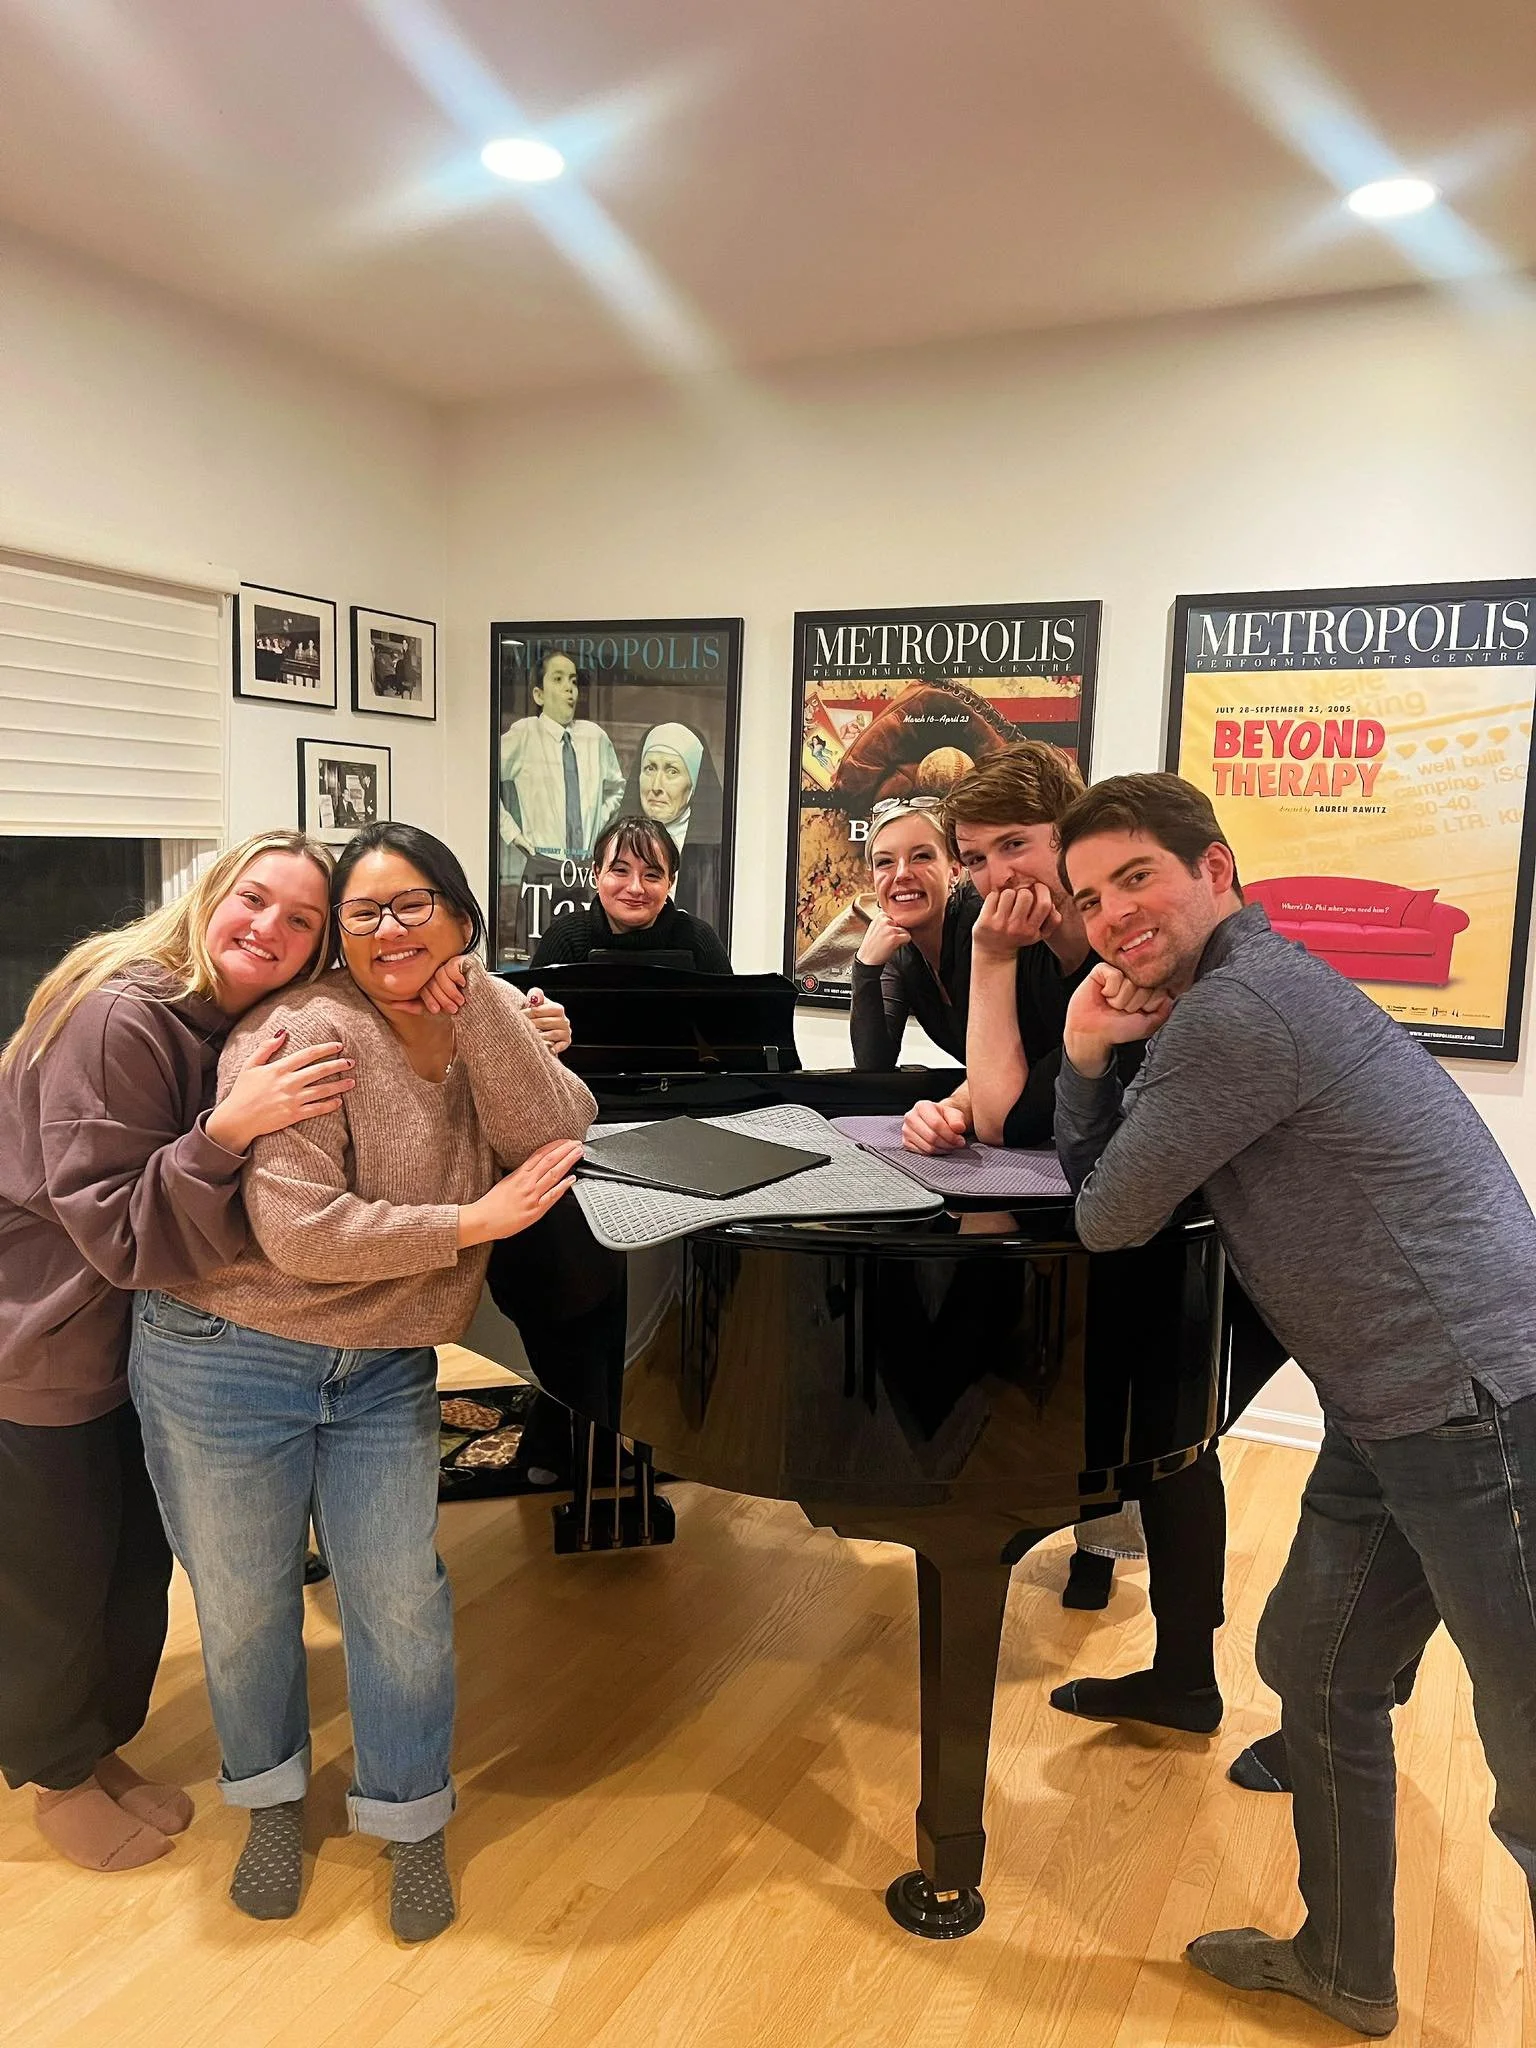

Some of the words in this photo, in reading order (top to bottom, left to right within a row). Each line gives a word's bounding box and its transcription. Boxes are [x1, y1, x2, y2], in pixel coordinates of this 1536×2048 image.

[1197, 601, 1529, 657] METROPOLIS
[813, 618, 1075, 667] METROPOLIS
[1197, 657, 1337, 669] PERFORMING
[1357, 655, 1411, 665] ARTS
[1431, 652, 1525, 662] CENTRE
[813, 667, 926, 677] PERFORMING
[941, 665, 984, 674] ARTS
[999, 663, 1072, 673] CENTRE
[1309, 706, 1323, 714] 25,
[1328, 705, 1351, 713] 2005
[903, 714, 925, 723] March
[960, 715, 970, 723] 23
[1214, 719, 1386, 760] BEYOND
[1212, 763, 1384, 798] THERAPY
[1315, 805, 1348, 813] LAUREN
[1352, 806, 1387, 814] RAWITZ
[1281, 903, 1303, 911] Where's
